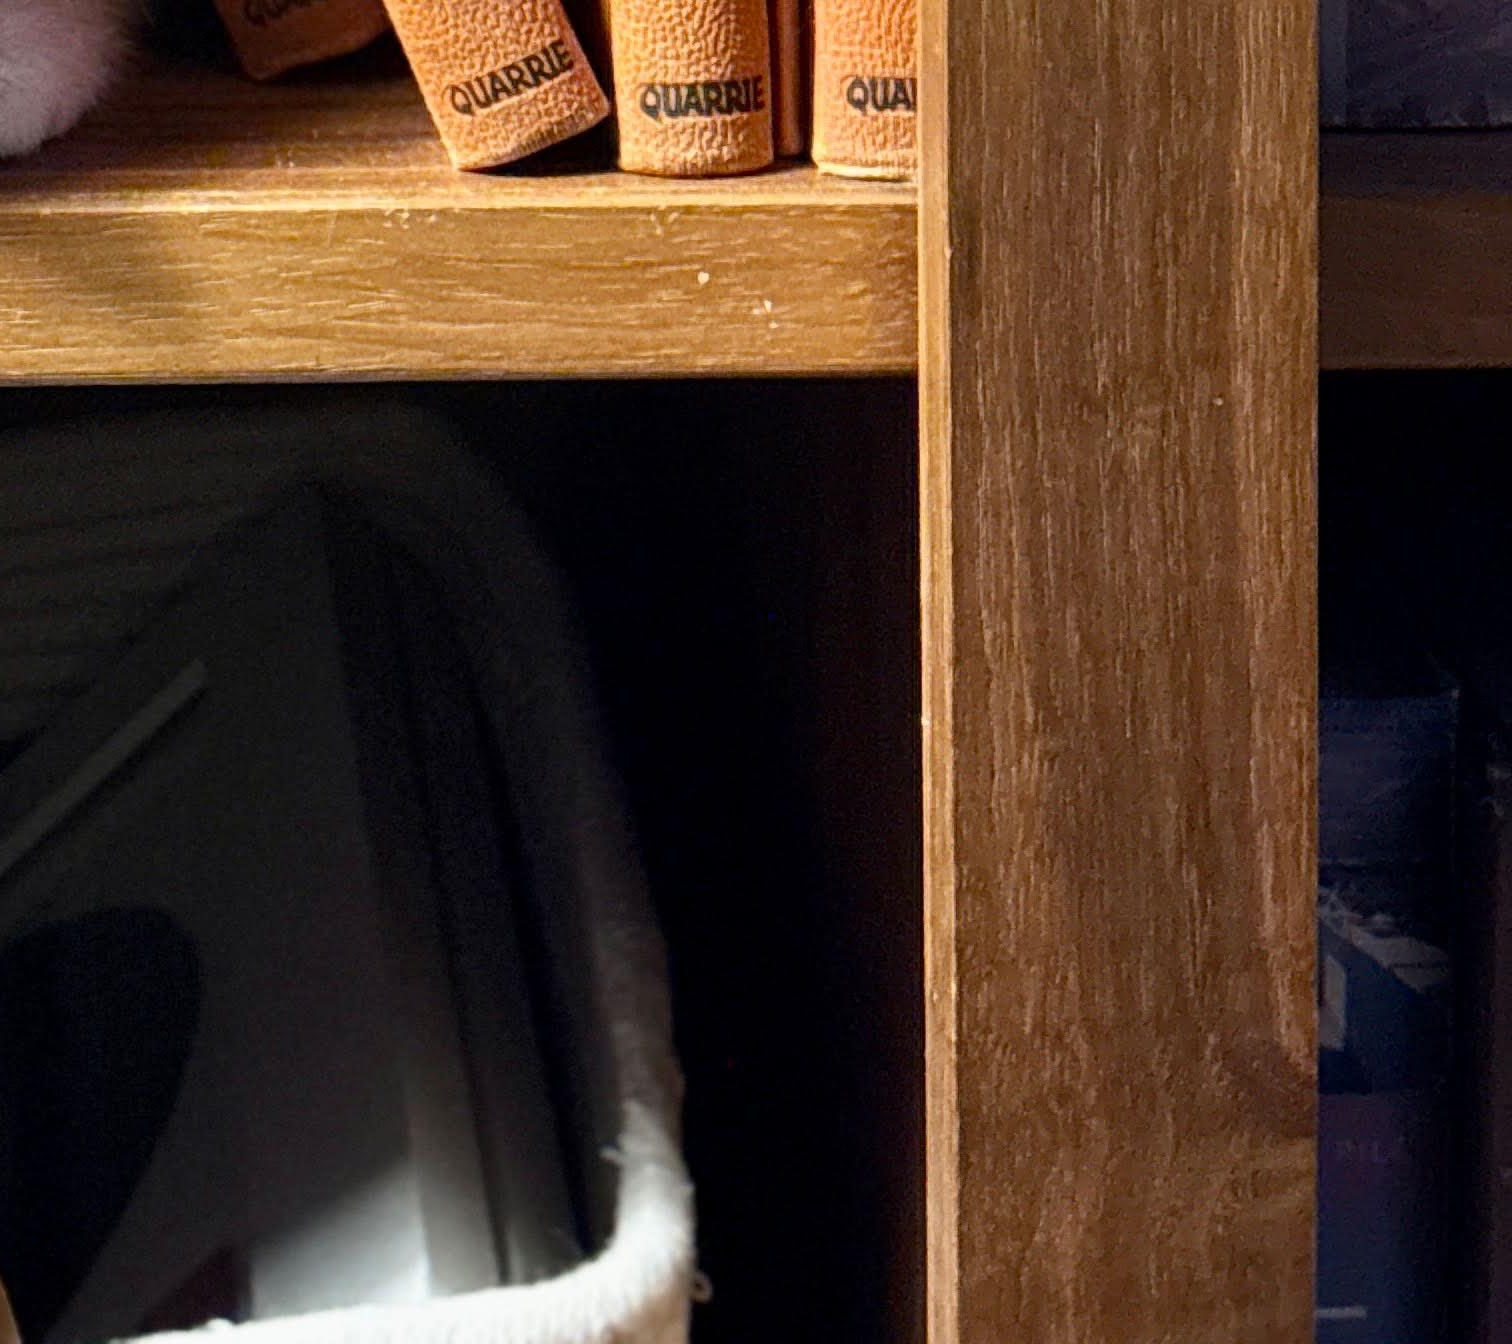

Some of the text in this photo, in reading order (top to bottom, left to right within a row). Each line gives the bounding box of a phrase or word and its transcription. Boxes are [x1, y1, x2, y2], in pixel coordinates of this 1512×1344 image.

[449, 39, 575, 117] QUARRIE
[638, 76, 767, 120] QUARRIE
[846, 74, 916, 116] QUA
